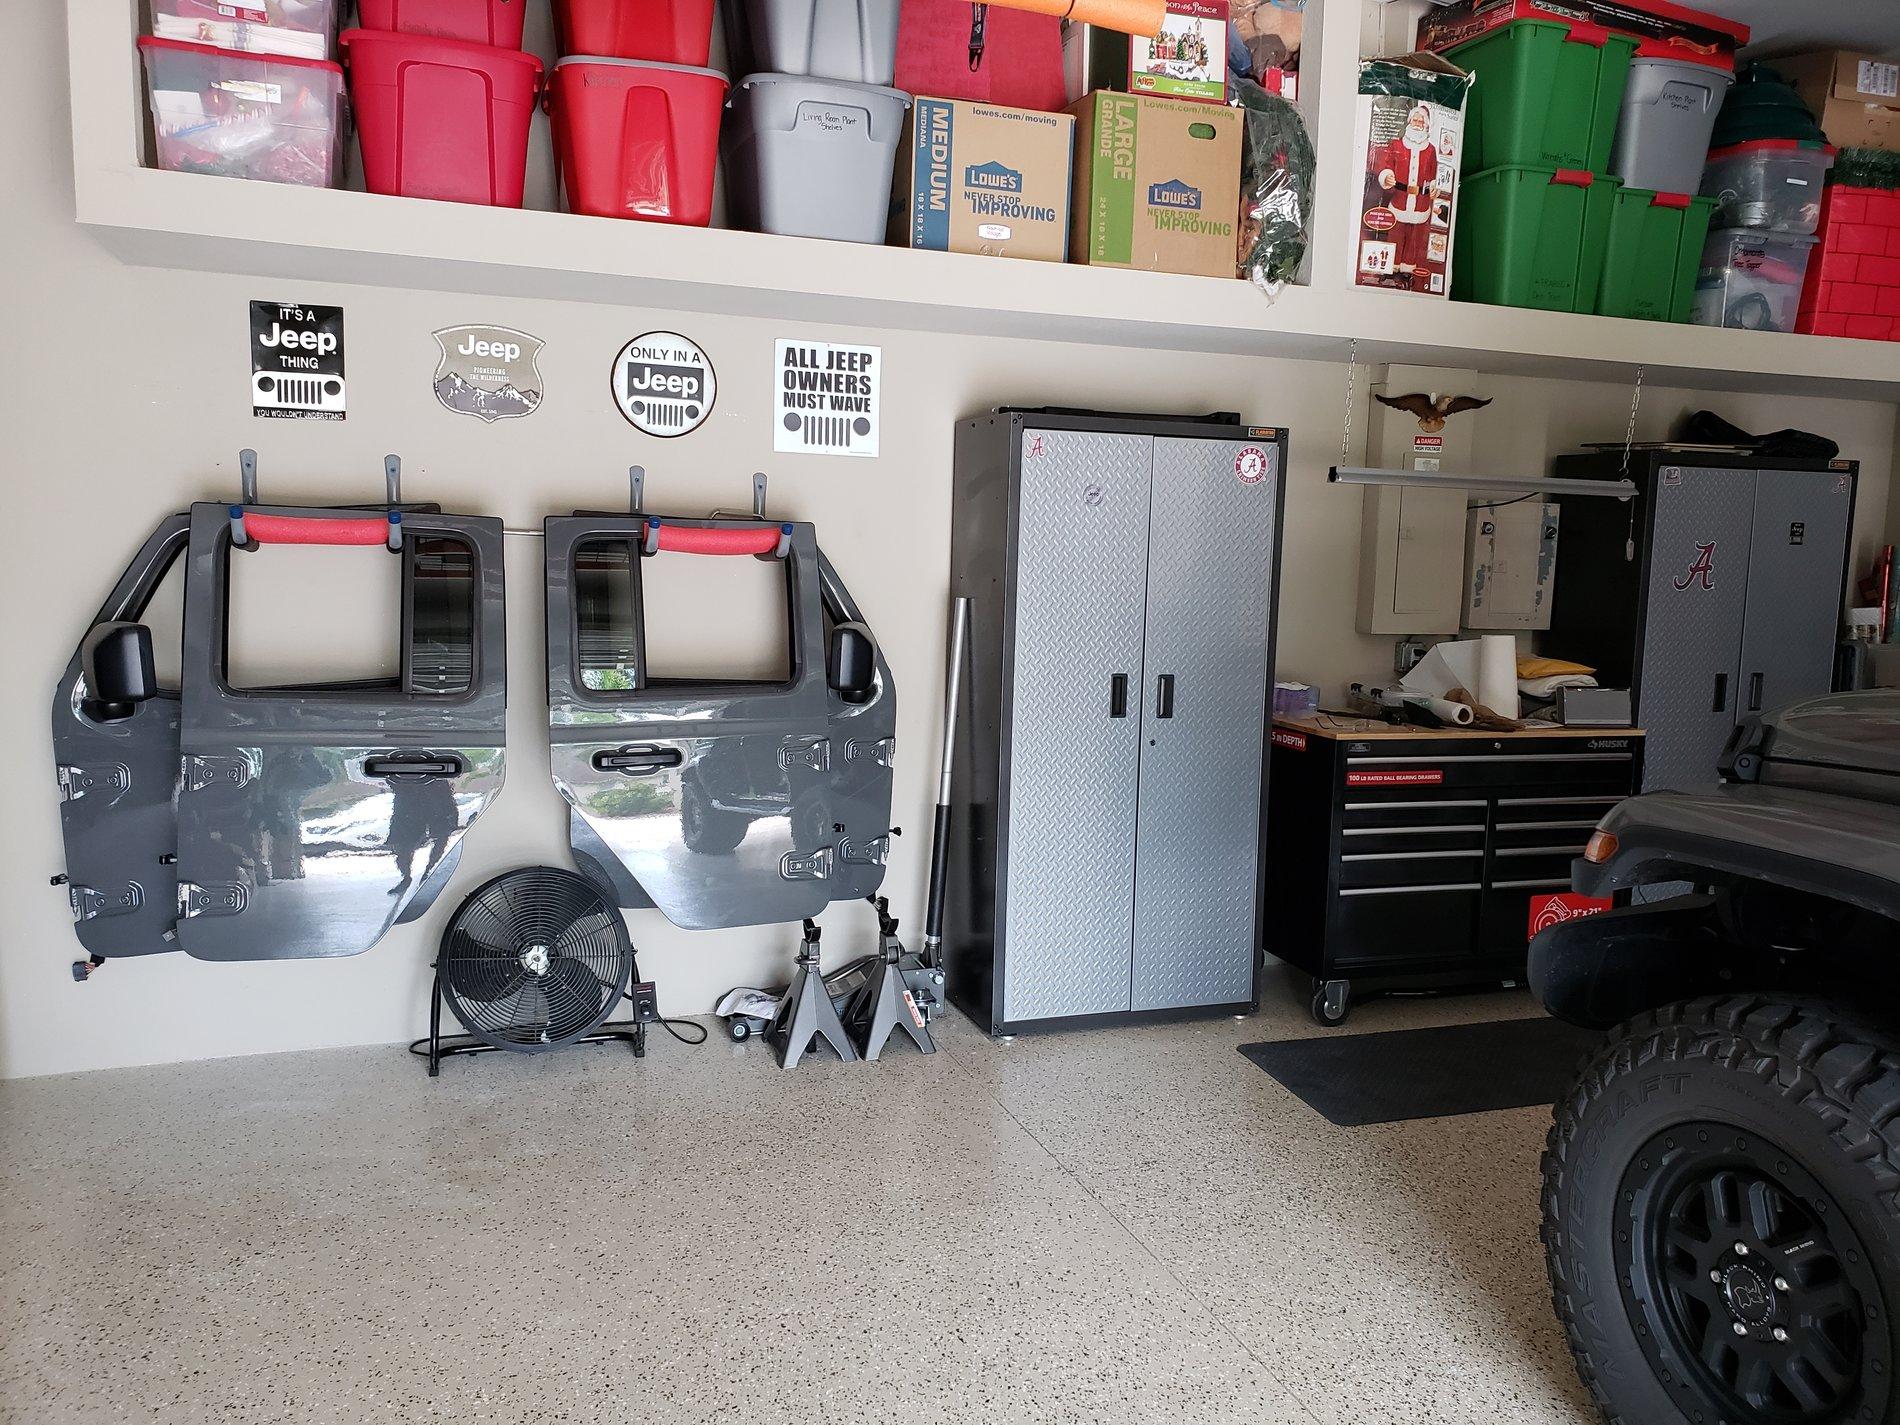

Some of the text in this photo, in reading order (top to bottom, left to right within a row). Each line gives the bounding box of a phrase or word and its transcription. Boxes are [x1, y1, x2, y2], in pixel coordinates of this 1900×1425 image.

[1192, 1, 1218, 14] Peace
[802, 111, 857, 125] Living Room Plant
[972, 107, 1057, 127] lowes.com/moving
[1144, 98, 1235, 120] Lowes.com/Moving
[821, 122, 843, 131] Shelves
[919, 105, 928, 148] MEDIANA
[1100, 98, 1114, 158] GRANDE
[1113, 101, 1135, 181] LARGE
[930, 107, 950, 211] MEDIUM
[970, 169, 1018, 190] LOWE'S
[917, 192, 925, 203] 18
[964, 191, 1021, 205] NEVER STOP
[1099, 196, 1107, 208] 24
[1153, 187, 1197, 207] LOWE'S
[917, 213, 924, 224] 18
[972, 199, 1056, 223] IMPROVING
[1147, 207, 1200, 221] NEVER STOP
[1154, 214, 1232, 237] IMPROVING
[279, 307, 316, 322] IT'S A
[259, 322, 338, 356] Jeep
[457, 334, 521, 363] Jeep
[279, 355, 319, 369] THING
[630, 346, 701, 364] ONLY IN A
[783, 346, 873, 373] ALL JEEP
[473, 366, 506, 375] PIONEERING
[480, 374, 510, 382] WILDERNESS
[632, 366, 699, 398] Jeep
[783, 369, 871, 396] OWNERS
[783, 391, 871, 413] MUST WAVE
[256, 408, 344, 421] YOU WOULDN'T UNDERSTAND
[1025, 436, 1045, 458] A
[1236, 448, 1266, 465] ALABAMA
[1243, 457, 1258, 473] A
[1673, 540, 1718, 592] A
[1598, 739, 1629, 748] HUSKY
[1722, 1264, 1766, 1288] BLACK RHINO
[1751, 1306, 1772, 1327] ALLOYS
